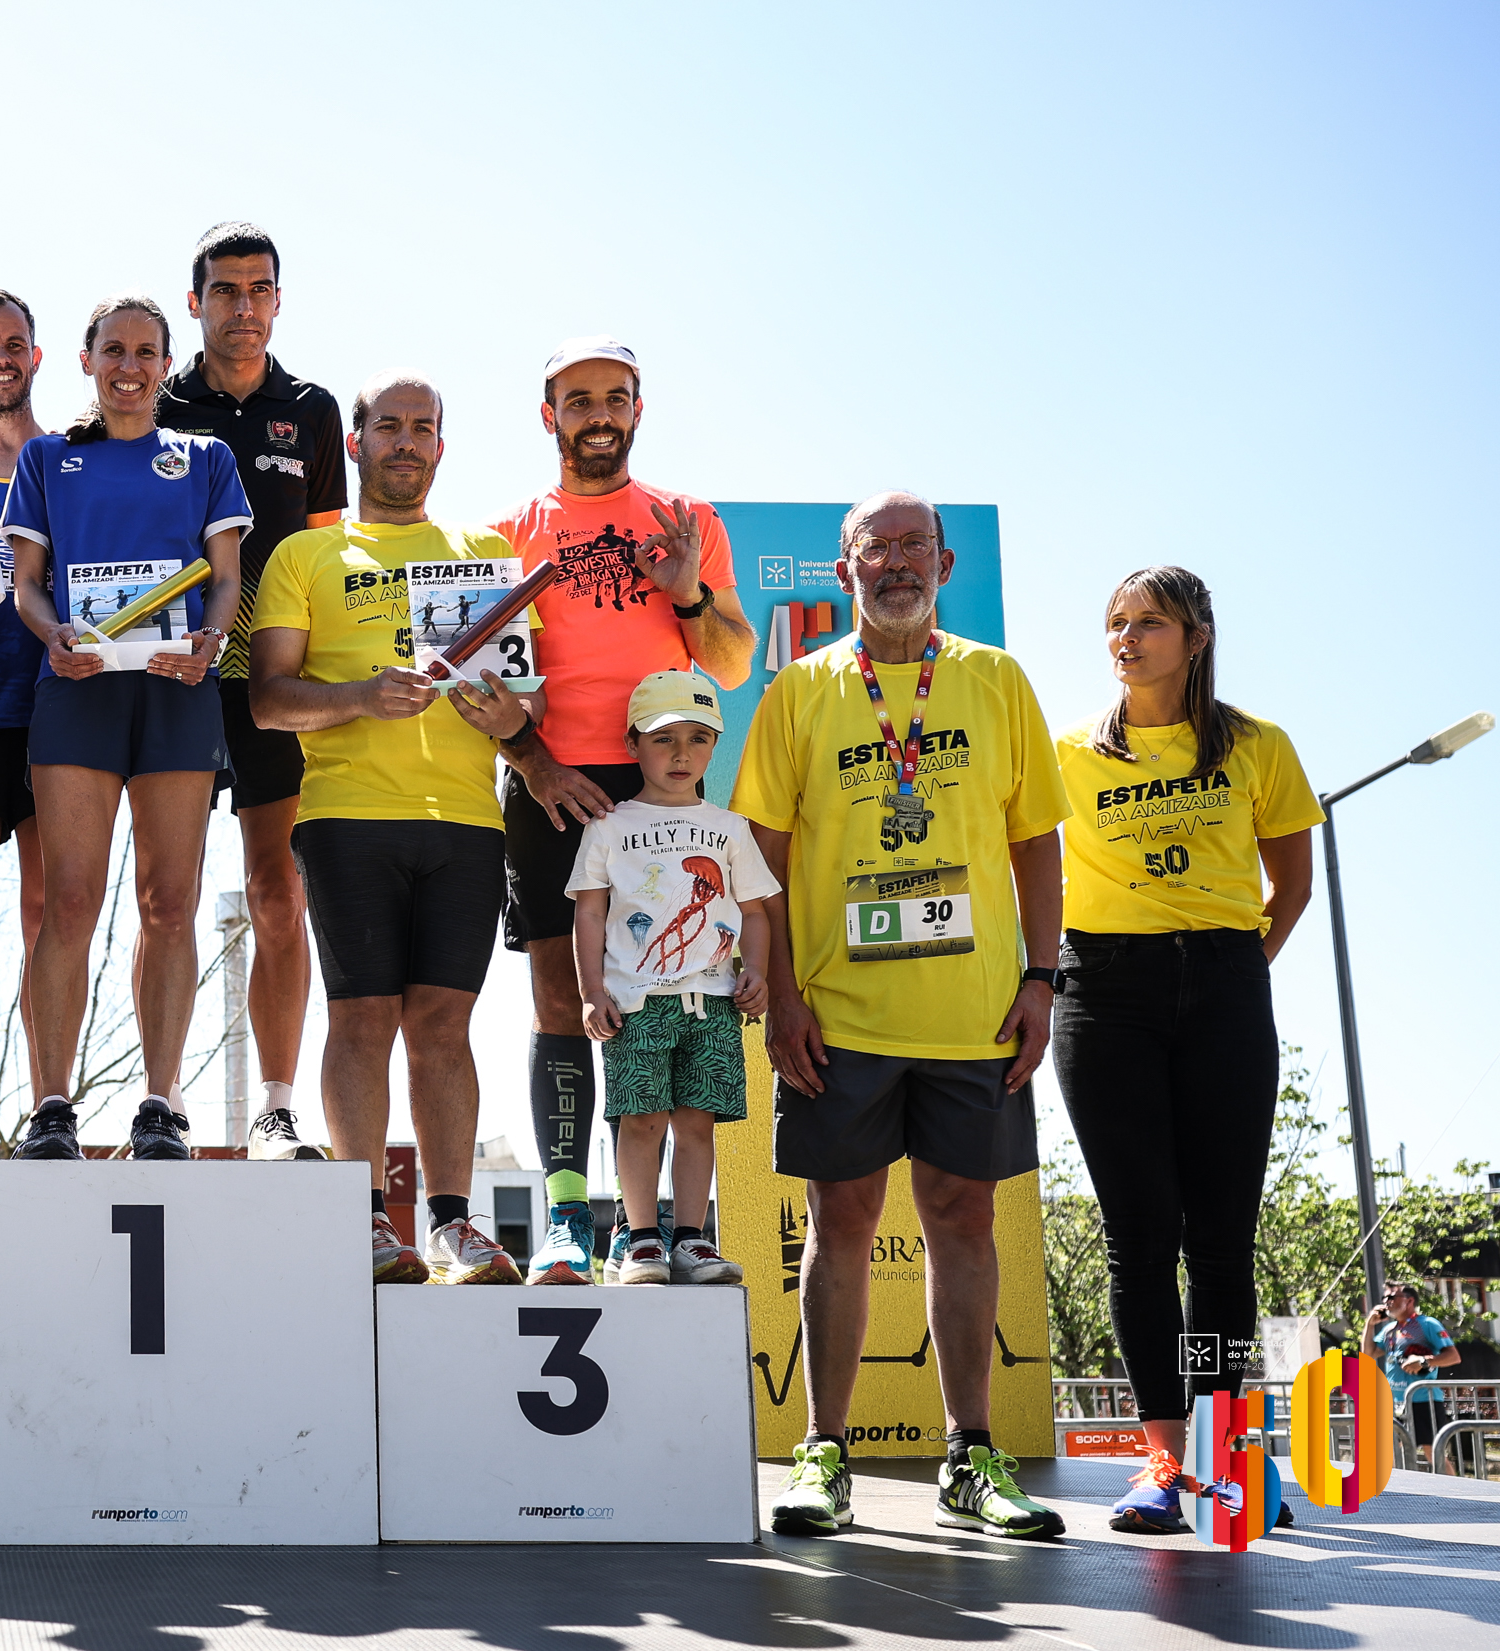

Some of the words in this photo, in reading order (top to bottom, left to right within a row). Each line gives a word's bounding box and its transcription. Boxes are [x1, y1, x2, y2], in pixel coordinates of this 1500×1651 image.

[271, 455, 304, 468] PREVENT
[71, 564, 154, 579] ESTAFETA
[344, 568, 407, 594] ESTA
[411, 563, 495, 579] ESTAFETA
[800, 578, 839, 587] 1974-2024
[345, 590, 377, 611] DA
[569, 590, 580, 600] 22
[152, 609, 173, 640] 1
[499, 634, 530, 677] 3
[838, 729, 970, 772] ESTETA
[840, 767, 871, 790] DA
[1097, 771, 1232, 811] ESTAFETA
[889, 797, 920, 809] FINISHER
[1098, 808, 1127, 828] DA
[1130, 791, 1231, 820] AMIZADE
[621, 828, 678, 852] JELLY
[690, 827, 729, 851] FISH
[1145, 843, 1190, 878] 50
[878, 871, 939, 895] ESTAFETA
[888, 889, 912, 898] AMIZADE
[869, 910, 891, 935] D
[921, 899, 953, 923] 30
[547, 1060, 583, 1160] kalenji
[870, 1235, 926, 1262] BRA
[111, 1204, 166, 1354] 1
[870, 1267, 926, 1284] Municípi
[516, 1306, 610, 1436] 3
